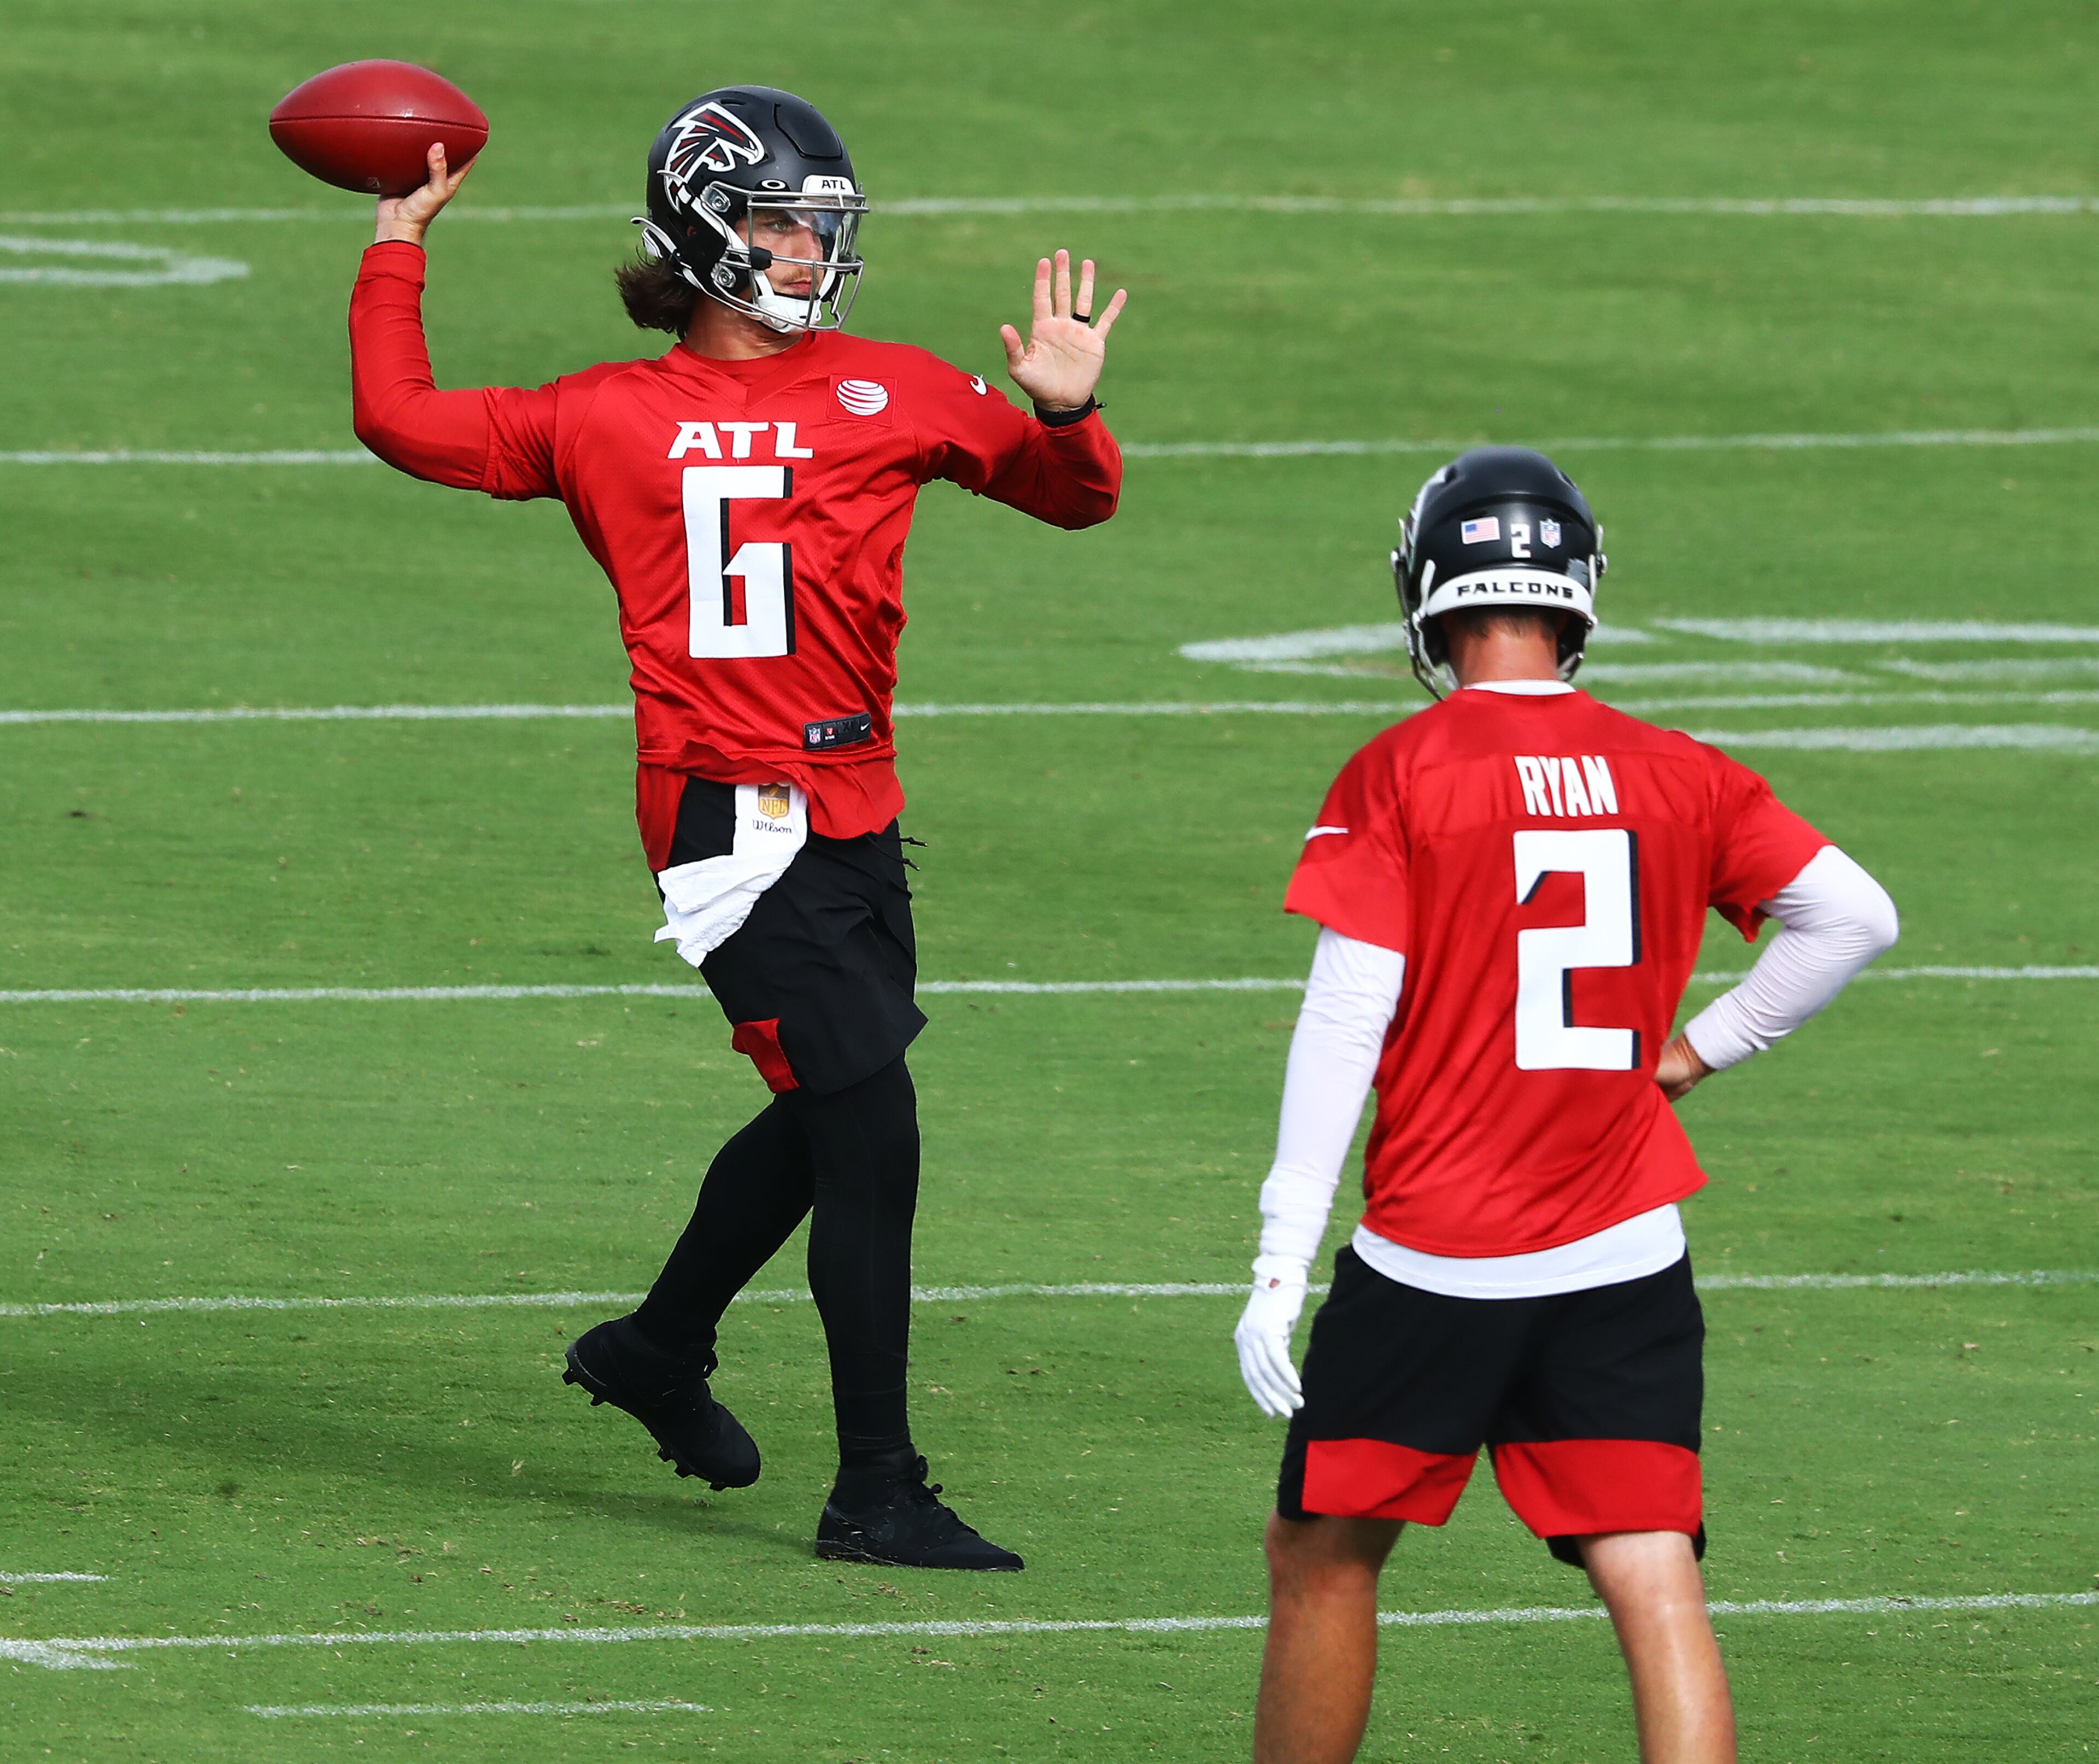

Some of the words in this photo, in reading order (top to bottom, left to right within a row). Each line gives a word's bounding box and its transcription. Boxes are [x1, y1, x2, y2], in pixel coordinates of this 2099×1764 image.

[822, 180, 845, 190] ATL
[667, 421, 813, 459] ATL
[1510, 523, 1531, 558] 2
[682, 466, 796, 658] 6
[1457, 582, 1573, 599] FALCONS
[1514, 755, 1619, 817] RYAN
[760, 799, 787, 815] NFL
[752, 819, 792, 834] Wilson
[1513, 829, 1640, 1070] 2
